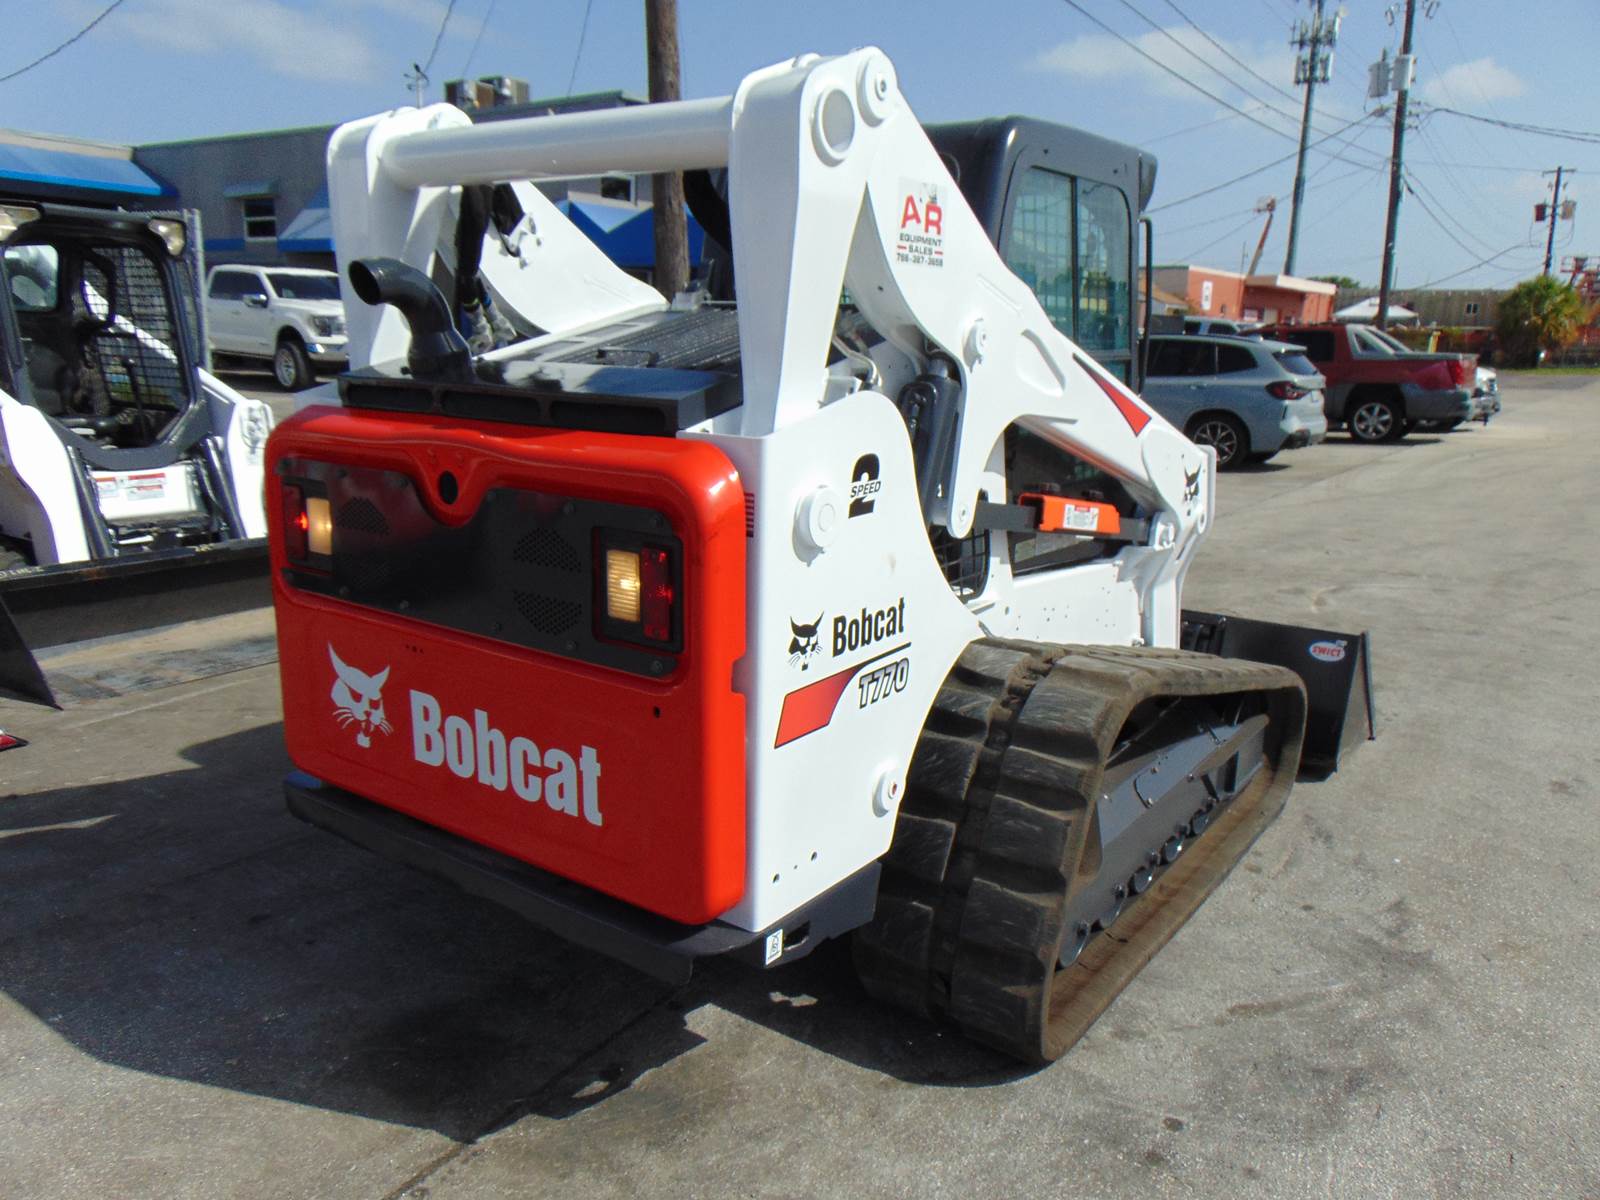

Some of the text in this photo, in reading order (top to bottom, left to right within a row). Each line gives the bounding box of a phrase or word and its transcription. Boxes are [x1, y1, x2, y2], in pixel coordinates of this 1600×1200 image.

[900, 233, 942, 246] EQUIPMENT
[908, 244, 934, 256] SALES
[850, 480, 882, 498] SPEED
[832, 597, 905, 658] Bobcat
[858, 657, 910, 710] T770
[409, 689, 604, 827] Bobcat
